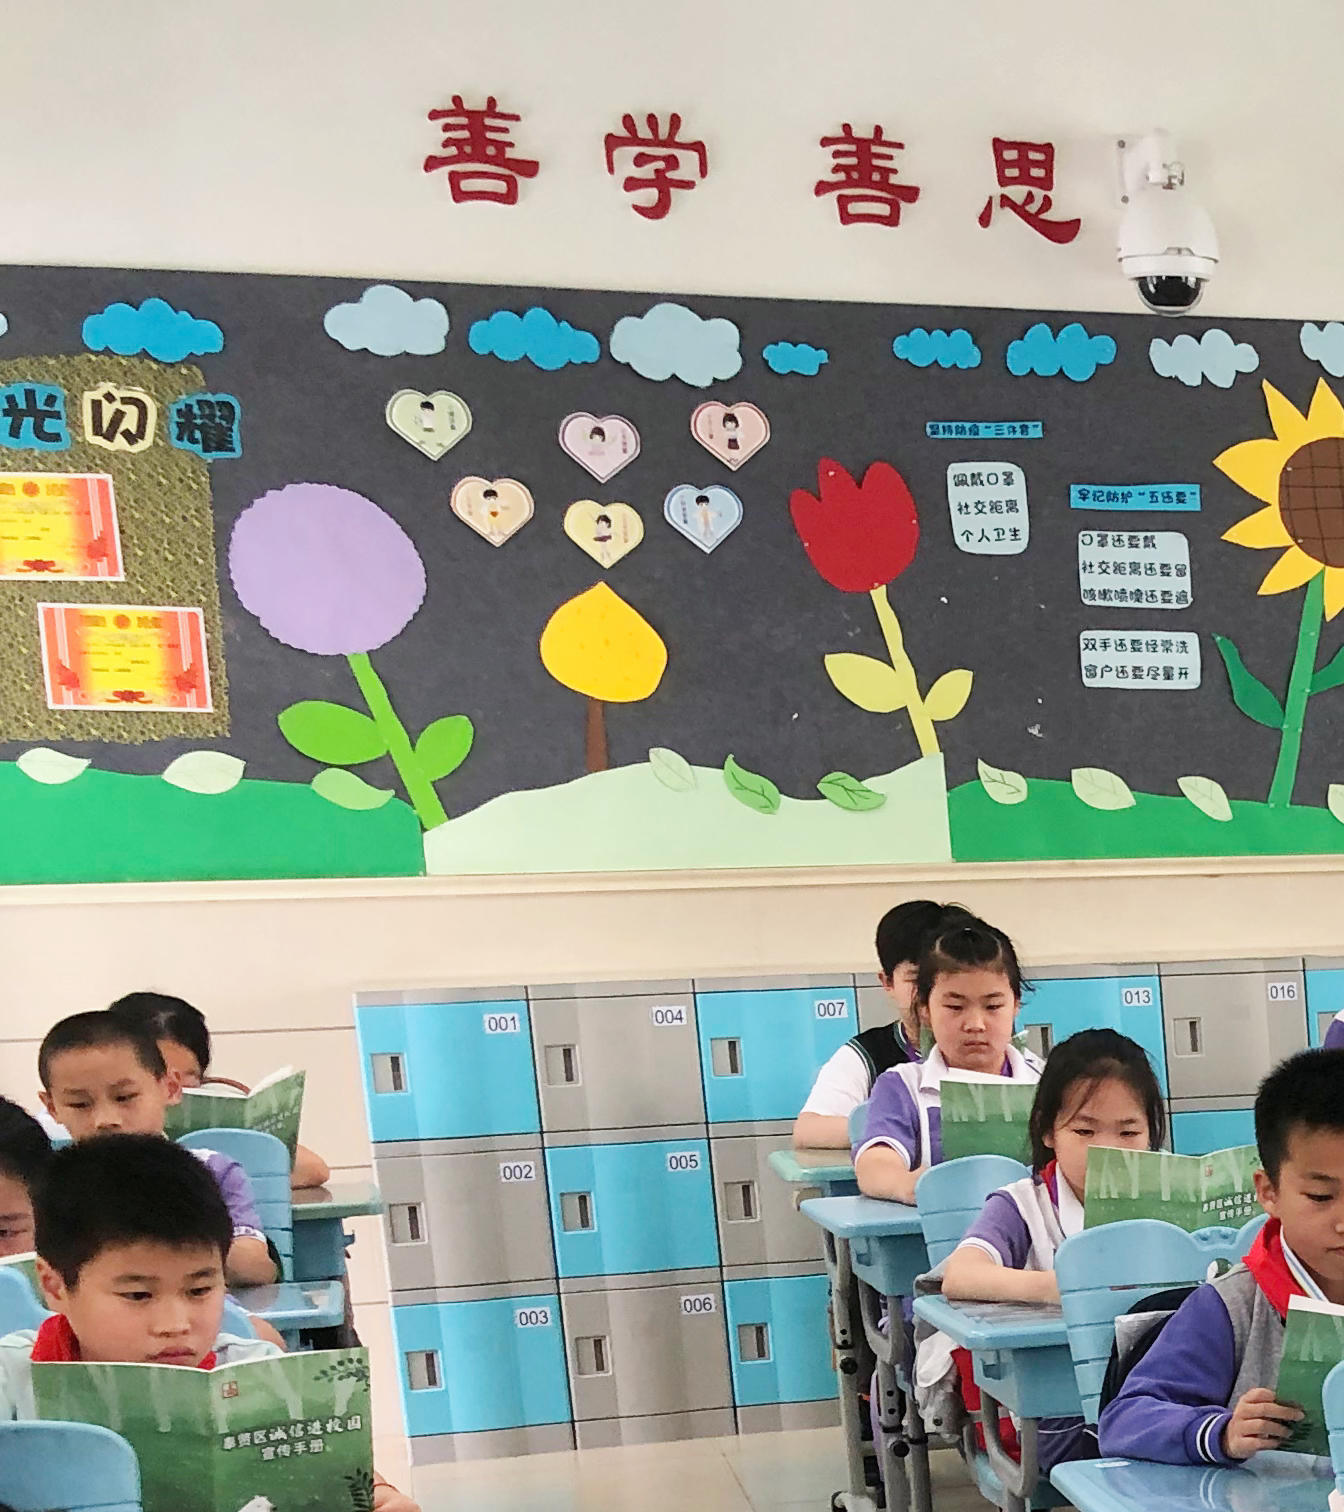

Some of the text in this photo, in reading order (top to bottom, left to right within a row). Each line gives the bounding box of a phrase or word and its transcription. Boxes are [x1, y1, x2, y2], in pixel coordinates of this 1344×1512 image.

[2, 387, 236, 453] 光闪耀
[957, 499, 1020, 515] 社交距离
[960, 527, 1022, 543] 个人卫生
[1125, 989, 1151, 1005] 013
[1270, 983, 1296, 1000] 016
[654, 1009, 684, 1025] 004
[817, 1002, 844, 1017] 007
[488, 1016, 517, 1032] 001
[669, 1153, 699, 1171] 005
[502, 1163, 533, 1181] 002
[683, 1296, 713, 1314] 006
[518, 1309, 550, 1327] 003
[261, 1438, 324, 1461] 宣传手册
